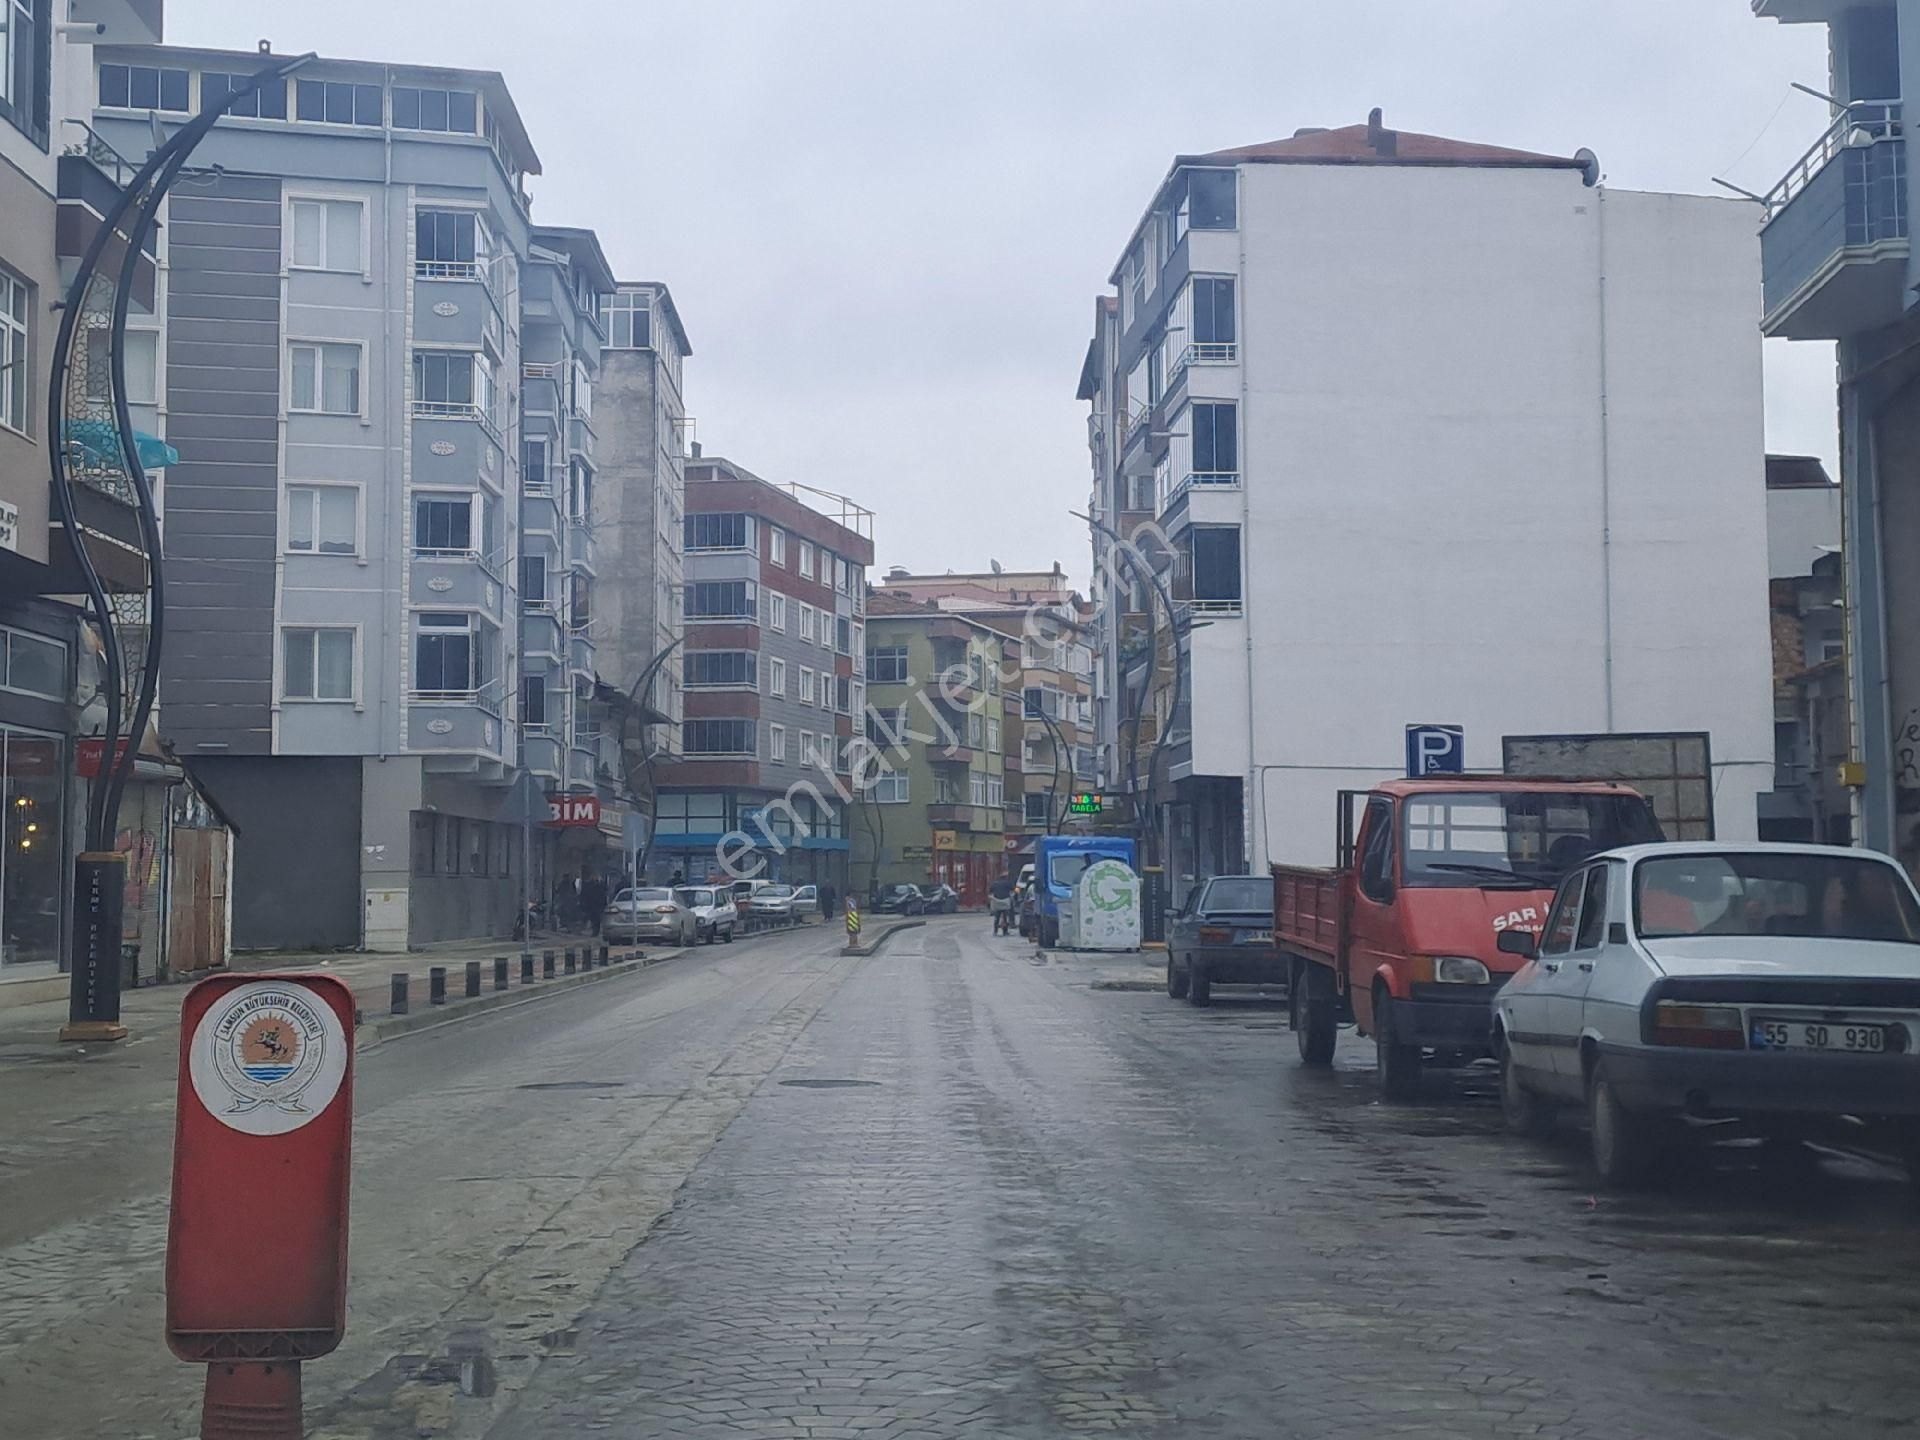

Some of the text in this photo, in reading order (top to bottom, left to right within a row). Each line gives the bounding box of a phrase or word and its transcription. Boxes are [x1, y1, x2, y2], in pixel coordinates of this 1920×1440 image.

[1418, 732, 1452, 775] P
[1493, 907, 1537, 932] SAR
[220, 1007, 245, 1035] SAMSUN
[1765, 1023, 1880, 1049] 55 SD 930
